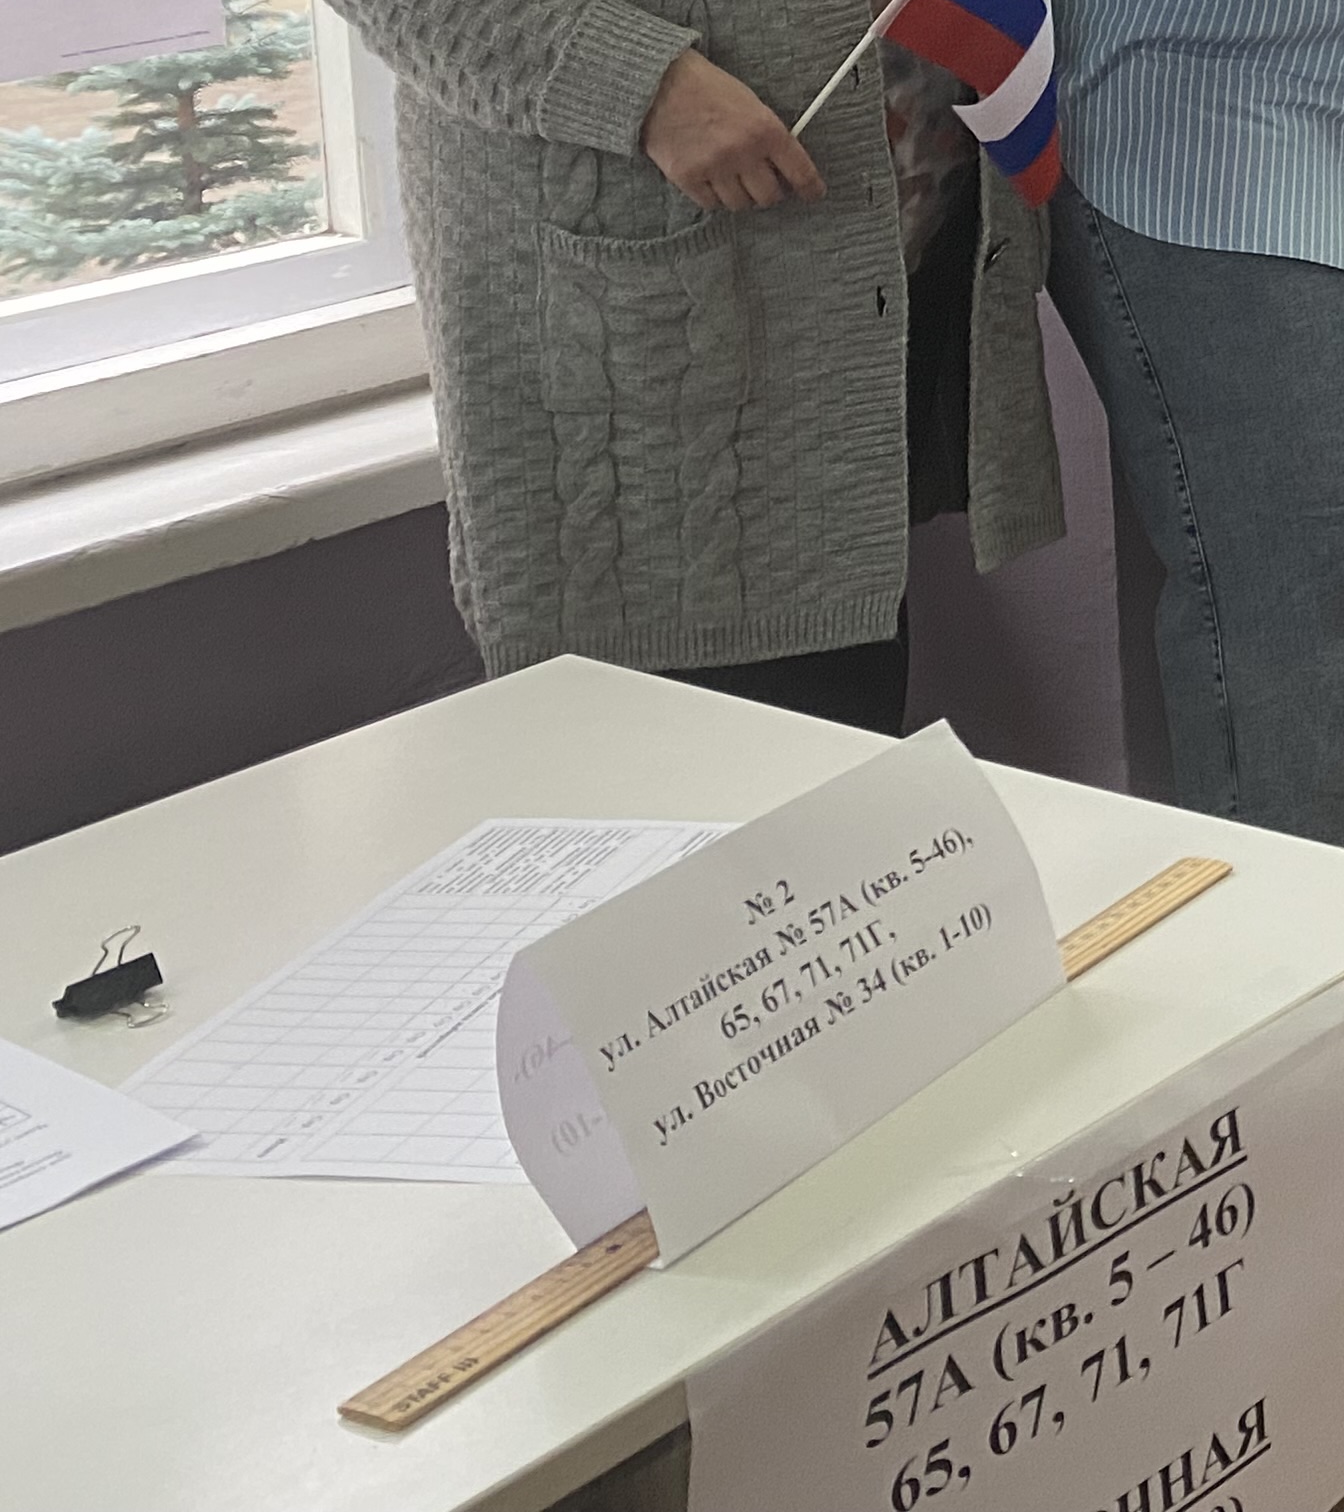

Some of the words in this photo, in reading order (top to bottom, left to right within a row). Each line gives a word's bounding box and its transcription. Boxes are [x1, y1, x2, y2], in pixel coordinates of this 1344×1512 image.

[599, 1033, 642, 1072] ул.
[646, 946, 774, 1038] Алтайская
[775, 923, 807, 956] №
[808, 894, 860, 935] 57А
[861, 872, 909, 907] (кв.
[909, 827, 975, 876] 5-46),
[721, 1003, 760, 1039] 65,
[761, 978, 802, 1013] 67,
[800, 955, 843, 988] 71,
[839, 919, 897, 963] 71Г,
[777, 879, 796, 906] 2
[652, 1105, 694, 1146] ул.
[693, 1015, 823, 1110] Восточная
[823, 990, 857, 1026] №
[856, 967, 888, 1004] 34
[891, 951, 937, 987] (кв.
[939, 902, 993, 951] 1-10)
[864, 1354, 976, 1449] 57А
[993, 1302, 1095, 1382] (кв.
[1108, 1250, 1135, 1307] 5
[1188, 1182, 1256, 1249] 46)
[868, 1105, 1247, 1368] АЛТАЙСКАЯ
[891, 1437, 971, 1512] 65,
[988, 1384, 1065, 1456] 67,
[1080, 1335, 1151, 1403] 71,
[1163, 1257, 1245, 1349] 71Г
